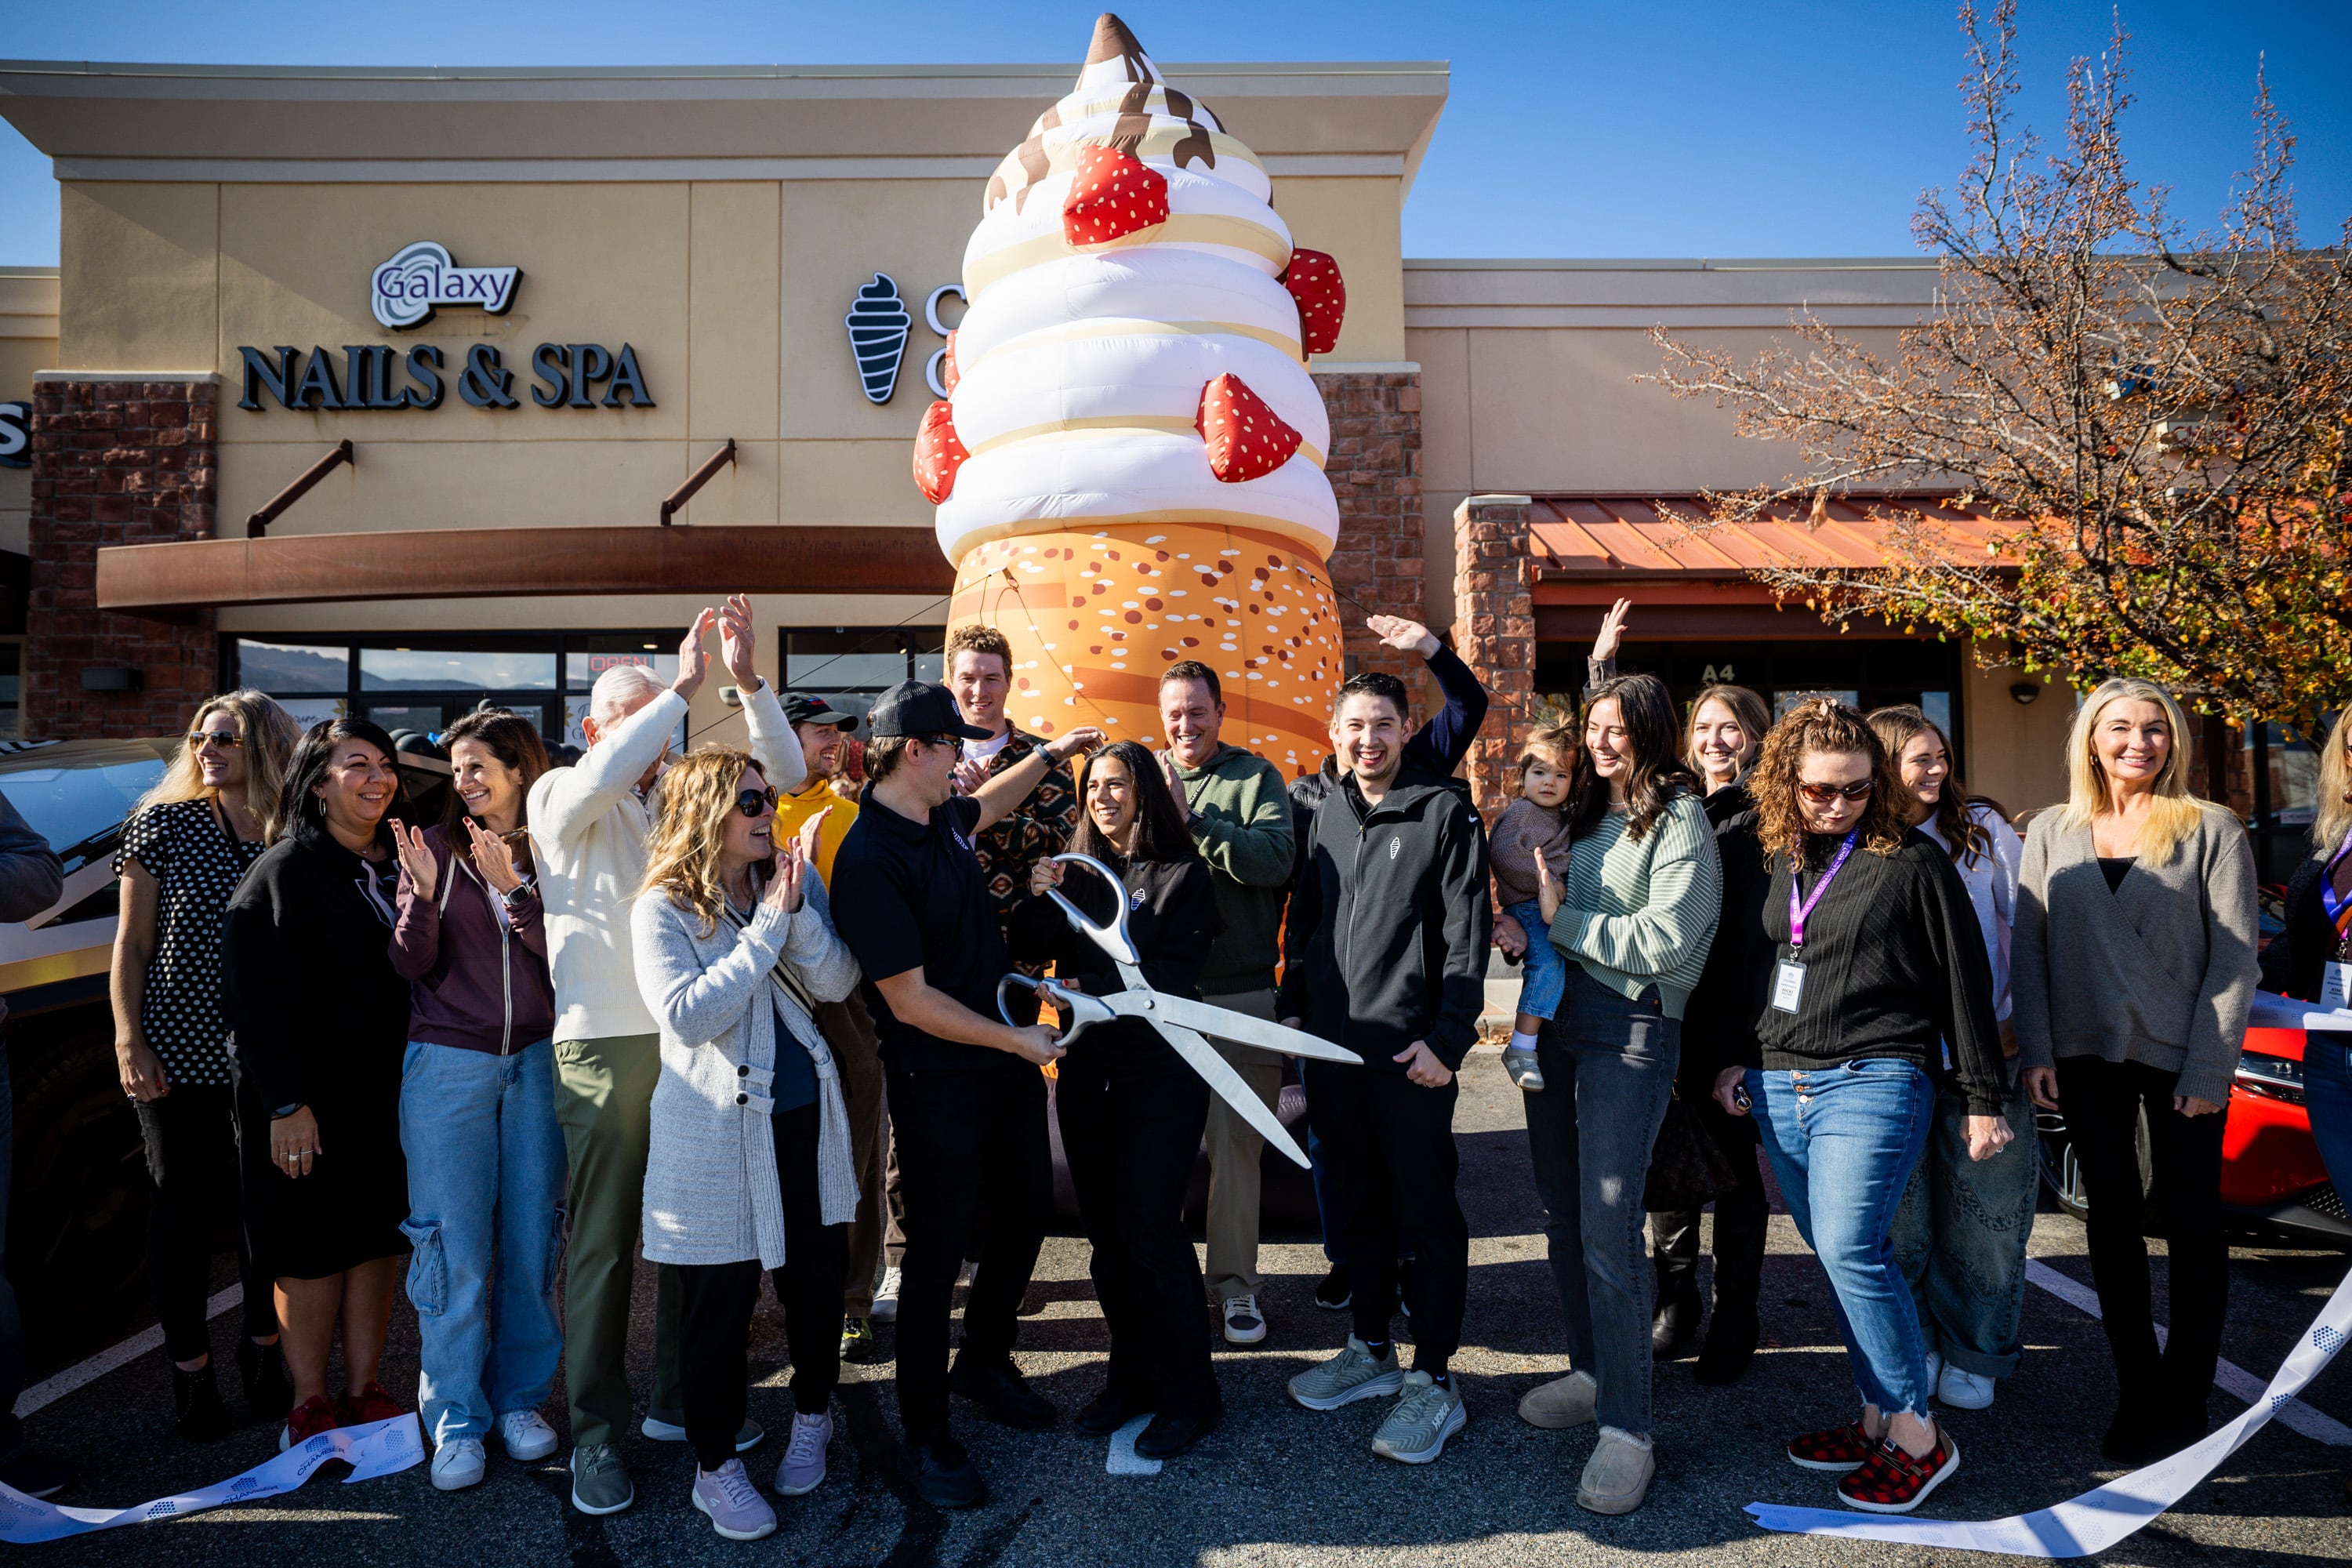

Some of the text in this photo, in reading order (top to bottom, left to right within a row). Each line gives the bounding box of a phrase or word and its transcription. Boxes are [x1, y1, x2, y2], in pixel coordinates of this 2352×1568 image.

[377, 263, 510, 307] Galaxy
[237, 343, 656, 410] NAILS & SPA
[1701, 663, 1736, 682] A4
[1809, 887, 1821, 907] VALLEY
[1432, 1402, 1450, 1433] HOKA
[297, 1446, 346, 1477] CHAMBER
[221, 1485, 279, 1505] CHAMBER
